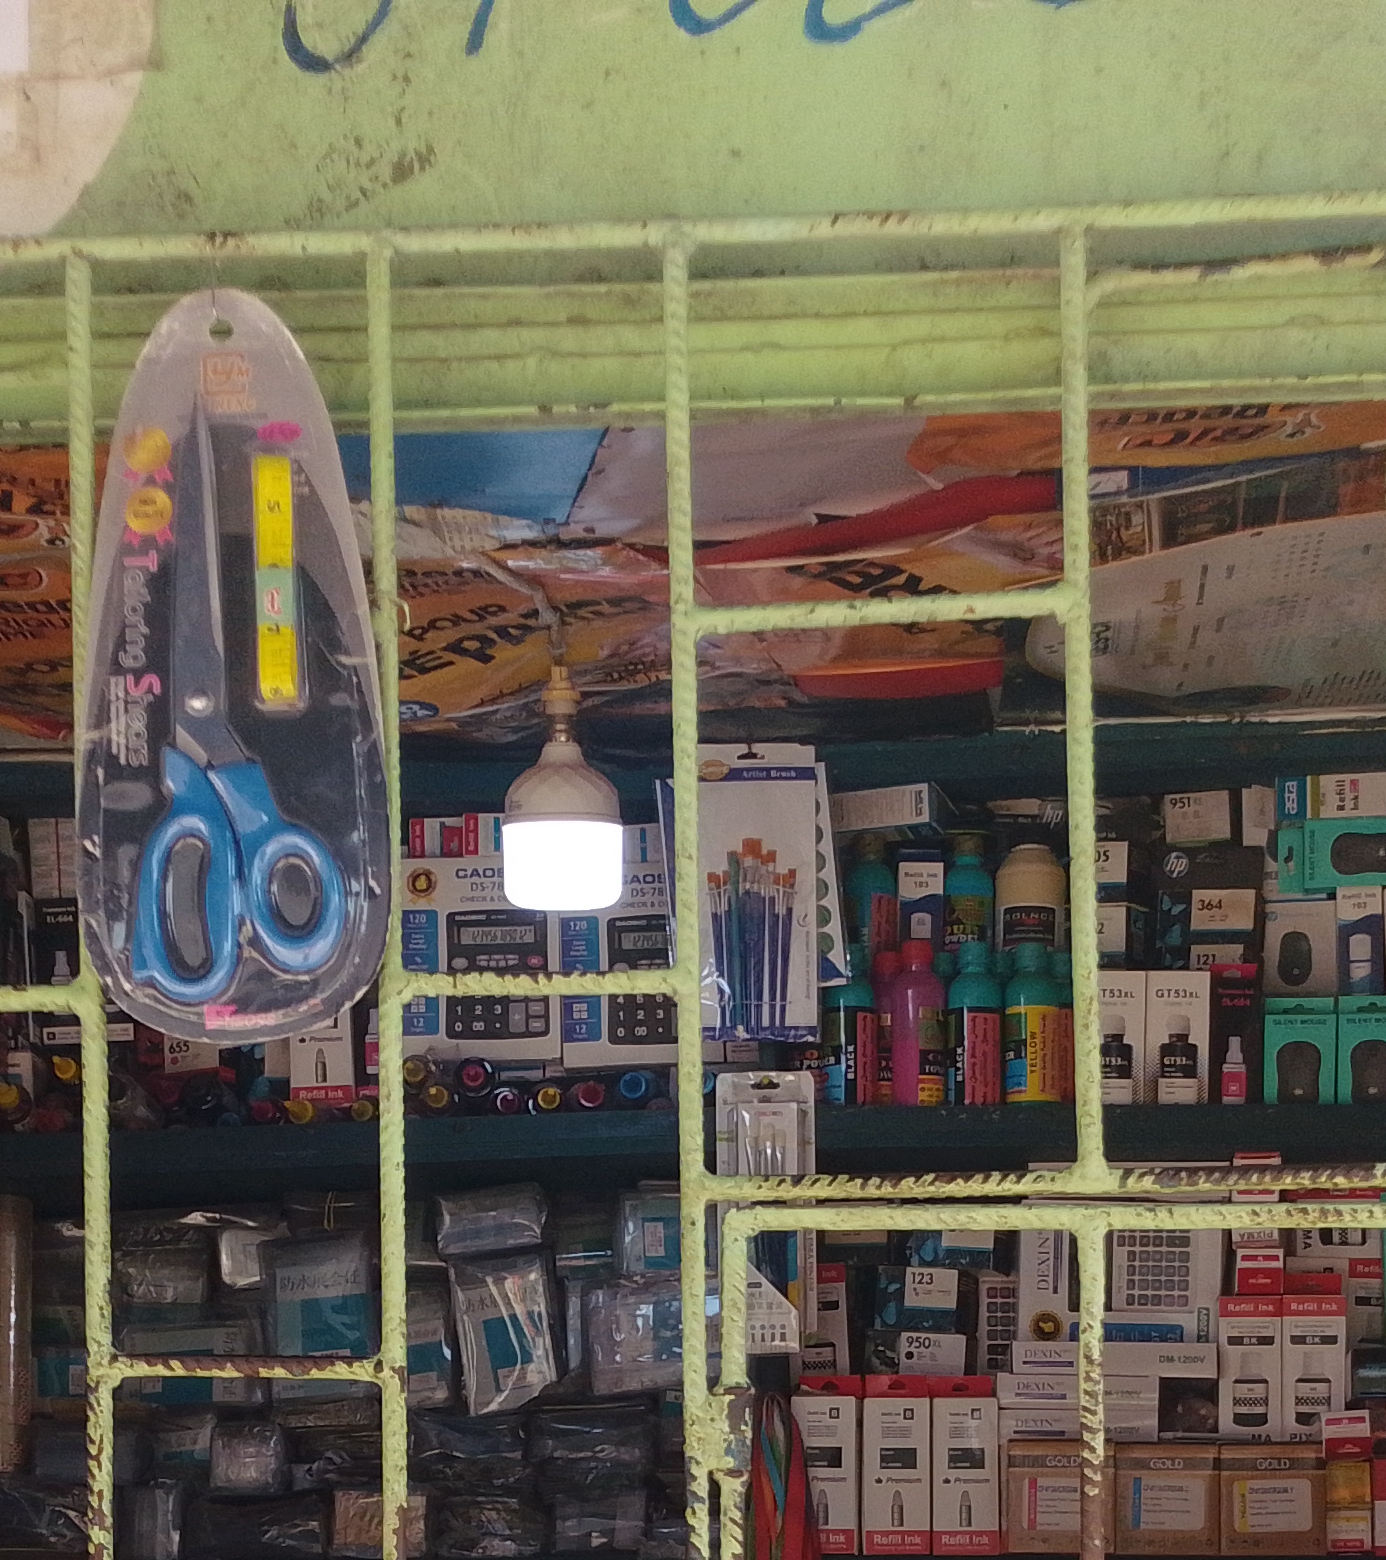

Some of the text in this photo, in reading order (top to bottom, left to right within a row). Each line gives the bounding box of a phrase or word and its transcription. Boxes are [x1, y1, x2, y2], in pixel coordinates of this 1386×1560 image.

[119, 550, 161, 768] Tailoring Shears
[1169, 796, 1192, 810] 951
[1042, 805, 1064, 829] hp
[1168, 855, 1188, 876] hp
[1197, 898, 1222, 912] 364
[408, 913, 427, 924] 120
[568, 920, 588, 931] 120
[412, 1017, 425, 1027] 12
[575, 1023, 587, 1034] 12
[167, 1039, 190, 1057] 655
[1029, 1030, 1037, 1075] YELLOW
[846, 1044, 855, 1079] BLACK
[956, 1046, 964, 1082] BLACK
[298, 1088, 344, 1101] Refill Ink
[1036, 1236, 1049, 1290] DEXIN
[910, 1271, 934, 1286] 123
[1227, 1303, 1275, 1313] Refill Ink
[1242, 1336, 1258, 1345] BK
[1305, 1336, 1321, 1345] BK
[1023, 1347, 1062, 1360] DEXIN
[1015, 1379, 1055, 1391] DEXIN
[1014, 1418, 1053, 1428] DEXIN
[1149, 1458, 1184, 1470] GOLD
[1256, 1458, 1290, 1469] GOLD
[873, 1533, 922, 1545] Refill Ink
[941, 1533, 990, 1545] Refill Ink
